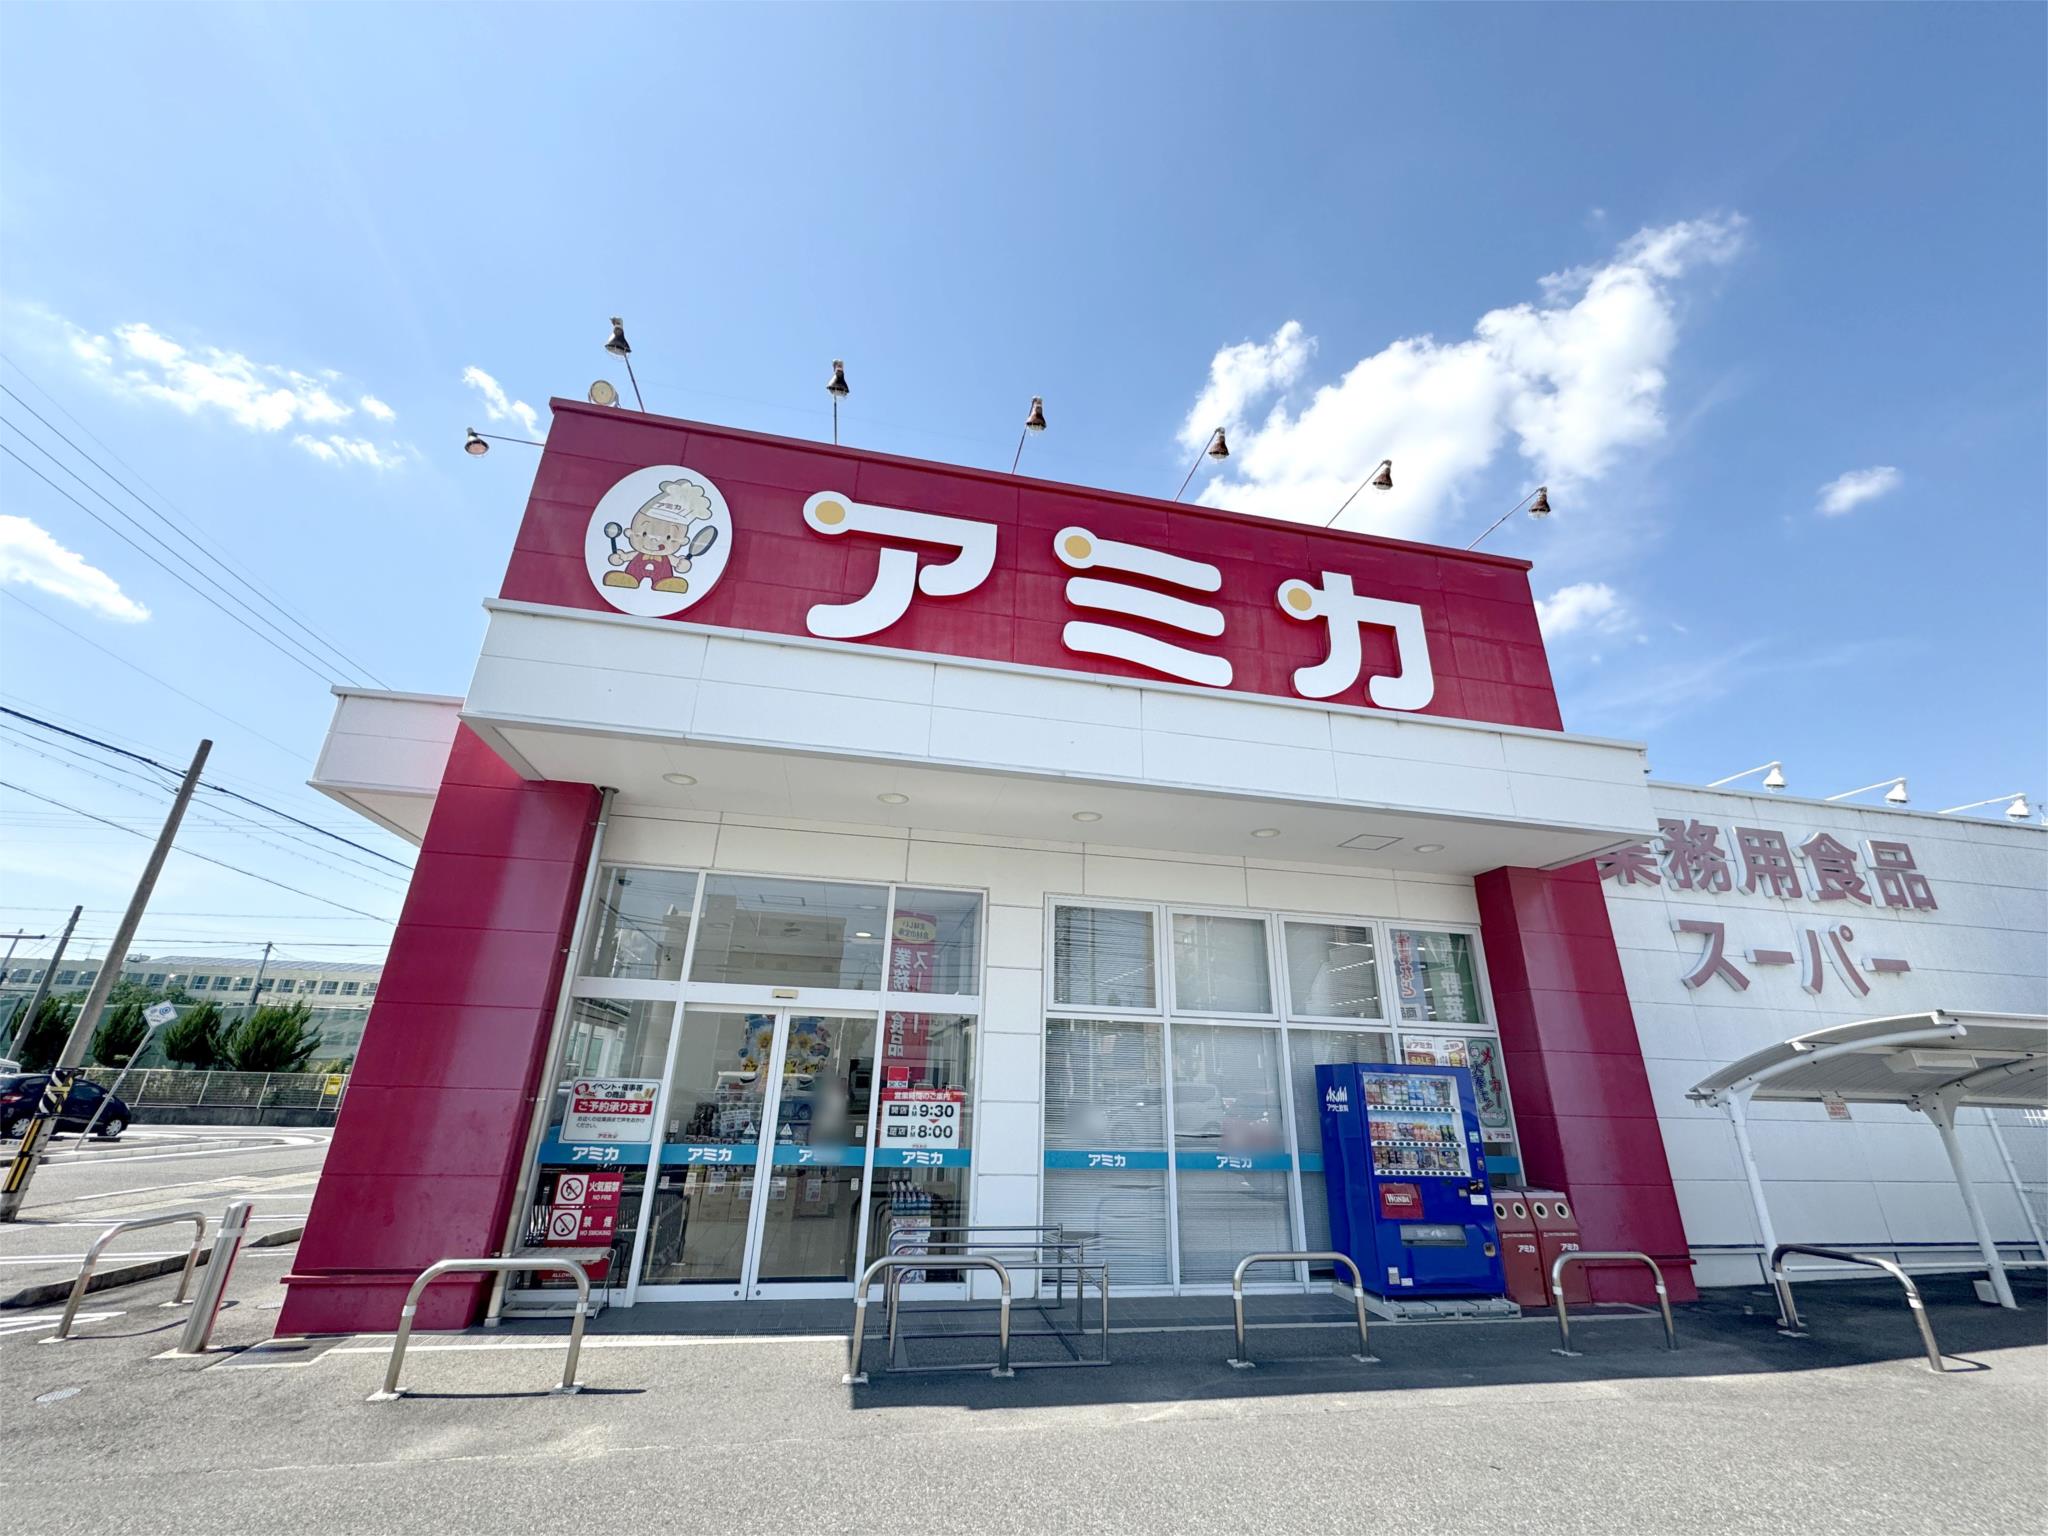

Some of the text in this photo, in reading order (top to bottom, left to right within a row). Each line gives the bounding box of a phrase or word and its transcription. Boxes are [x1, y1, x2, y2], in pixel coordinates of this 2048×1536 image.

[803, 491, 1434, 710] アミカ
[1674, 919, 1911, 998] スーパー
[578, 1101, 648, 1112] ご予約承ります
[920, 1105, 954, 1117] 9:30
[918, 1125, 953, 1138] 8:00
[572, 1146, 619, 1161] アミカ
[688, 1147, 732, 1162] アミカ
[902, 1151, 943, 1164] アミカ
[1088, 1154, 1126, 1167] アミカ
[1216, 1155, 1252, 1168] アミカ
[1518, 1245, 1535, 1253] アミカ
[1561, 1243, 1579, 1251] アミカ
